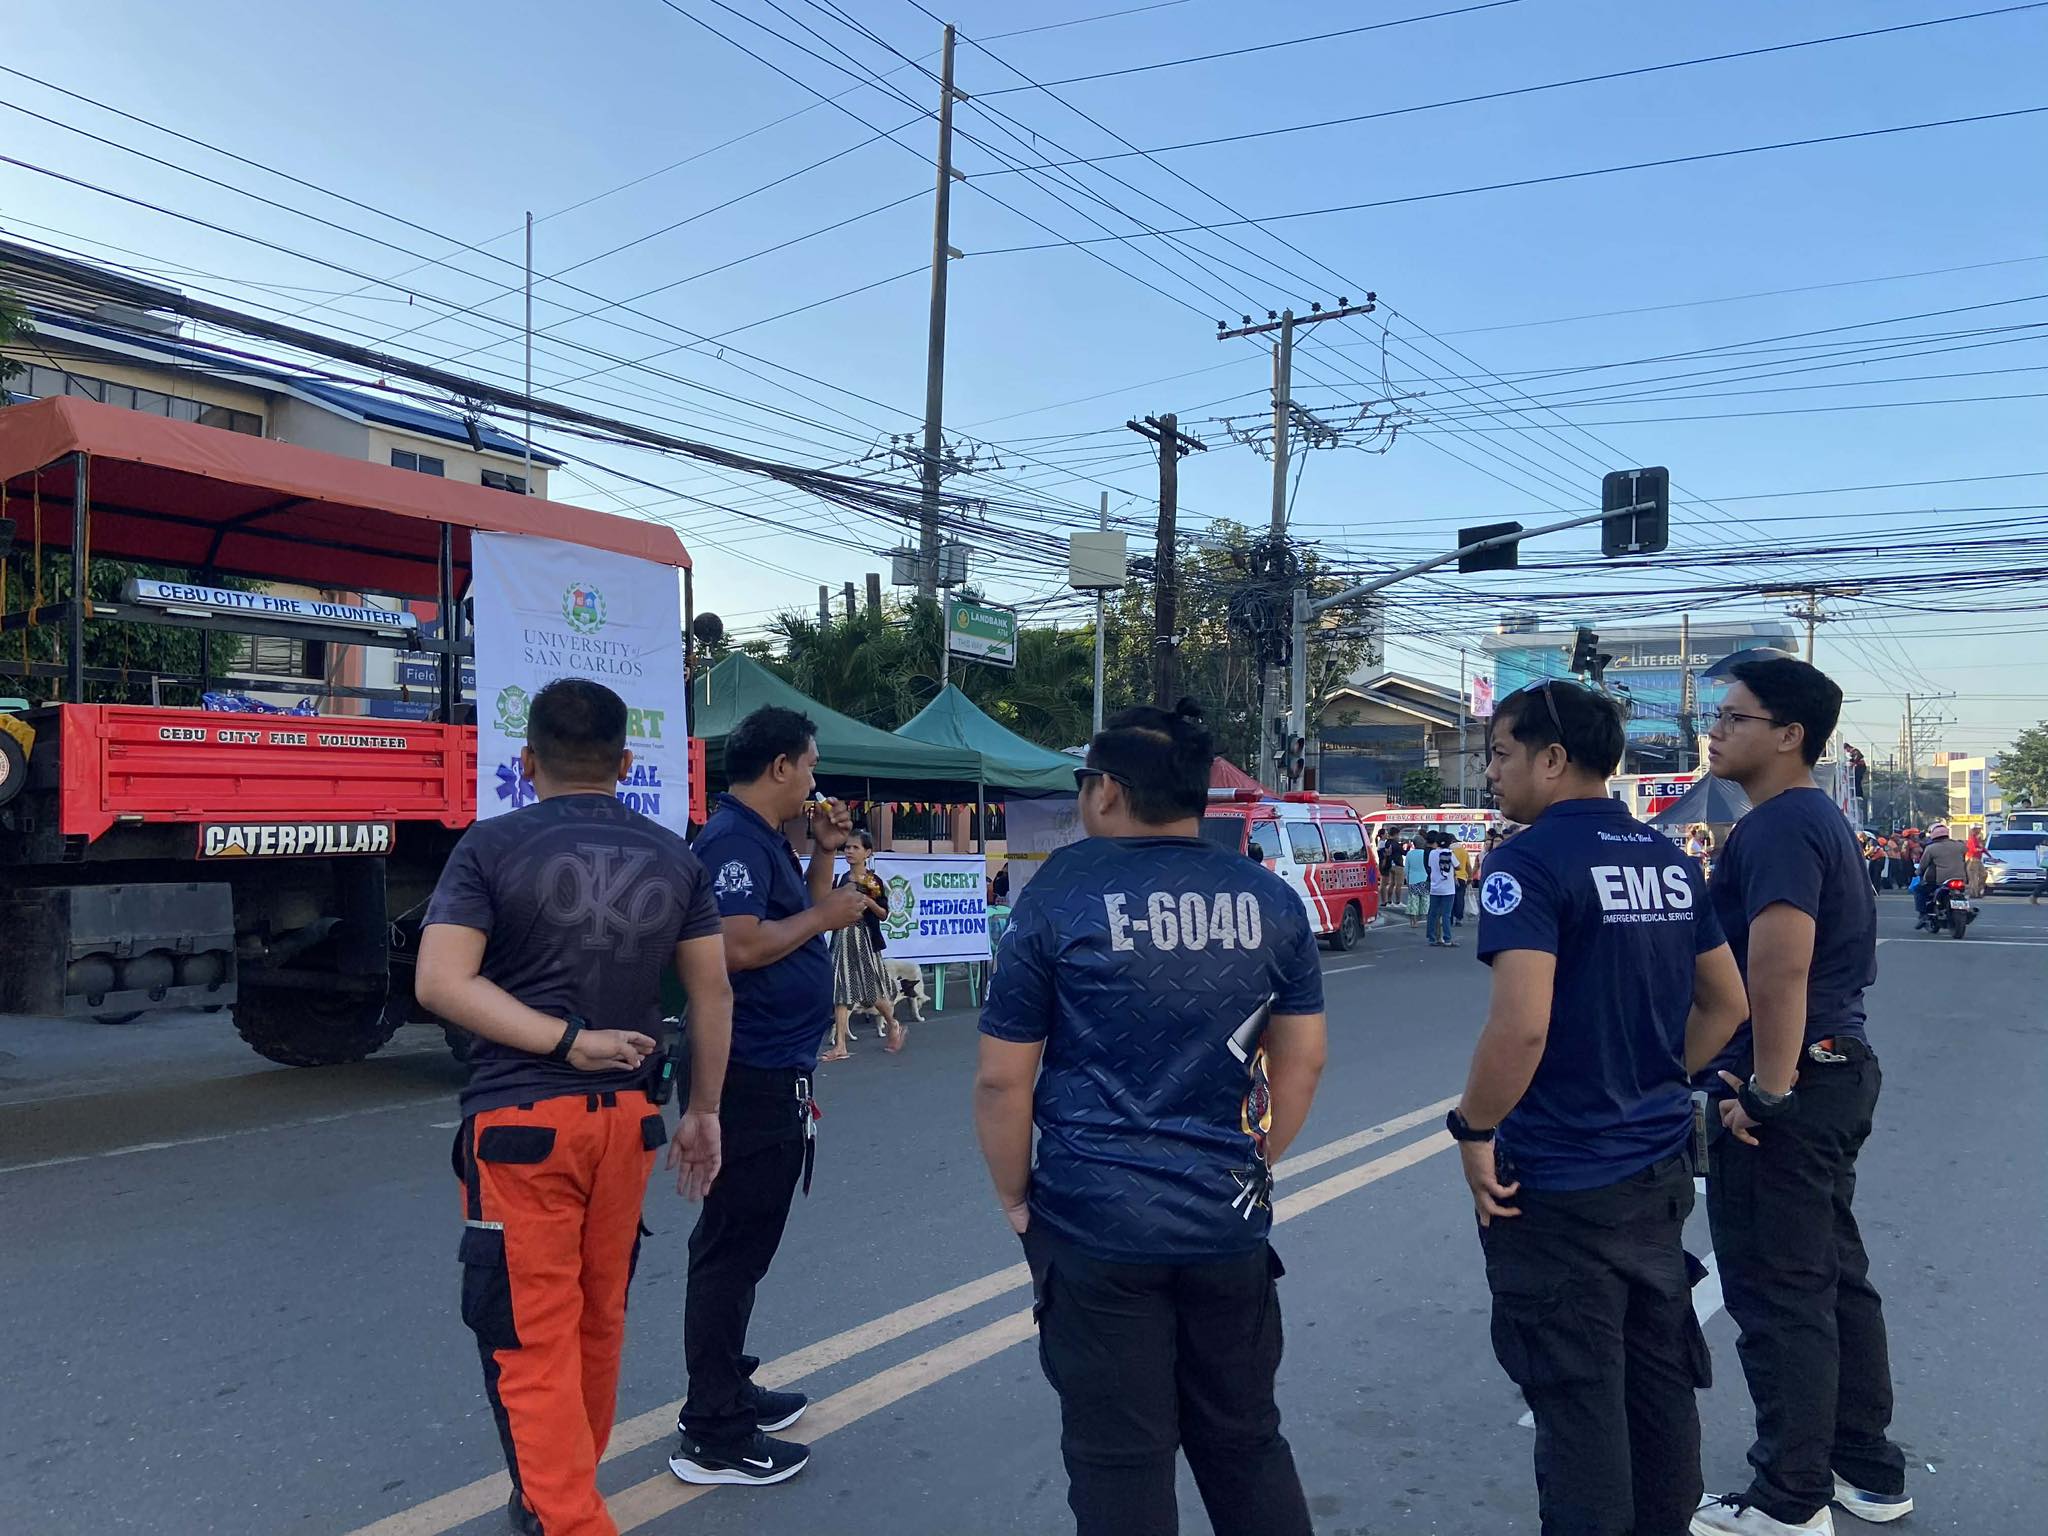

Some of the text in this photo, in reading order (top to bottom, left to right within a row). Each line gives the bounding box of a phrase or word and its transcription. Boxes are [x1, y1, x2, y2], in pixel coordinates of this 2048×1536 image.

[158, 584, 401, 625] CEBU CITY FIRE VOLUNTEER
[970, 611, 1008, 628] LANDBANK
[523, 629, 630, 657] UNIVERSITY
[524, 647, 562, 666] SAN
[569, 653, 643, 677] CARLOS
[1631, 653, 1708, 667] LITE FERIES
[160, 727, 407, 749] CEBU CITY FIRE VOLUNTEER
[204, 824, 390, 857] CATERPILLAR
[923, 872, 980, 889] USCERT
[1590, 865, 1693, 911] EMS
[919, 898, 986, 915] MEDICAL
[919, 918, 986, 937] STATION
[1103, 891, 1262, 952] E-6040
[1603, 913, 1639, 924] EMERGENCY
[1640, 913, 1667, 922] MEDICAL
